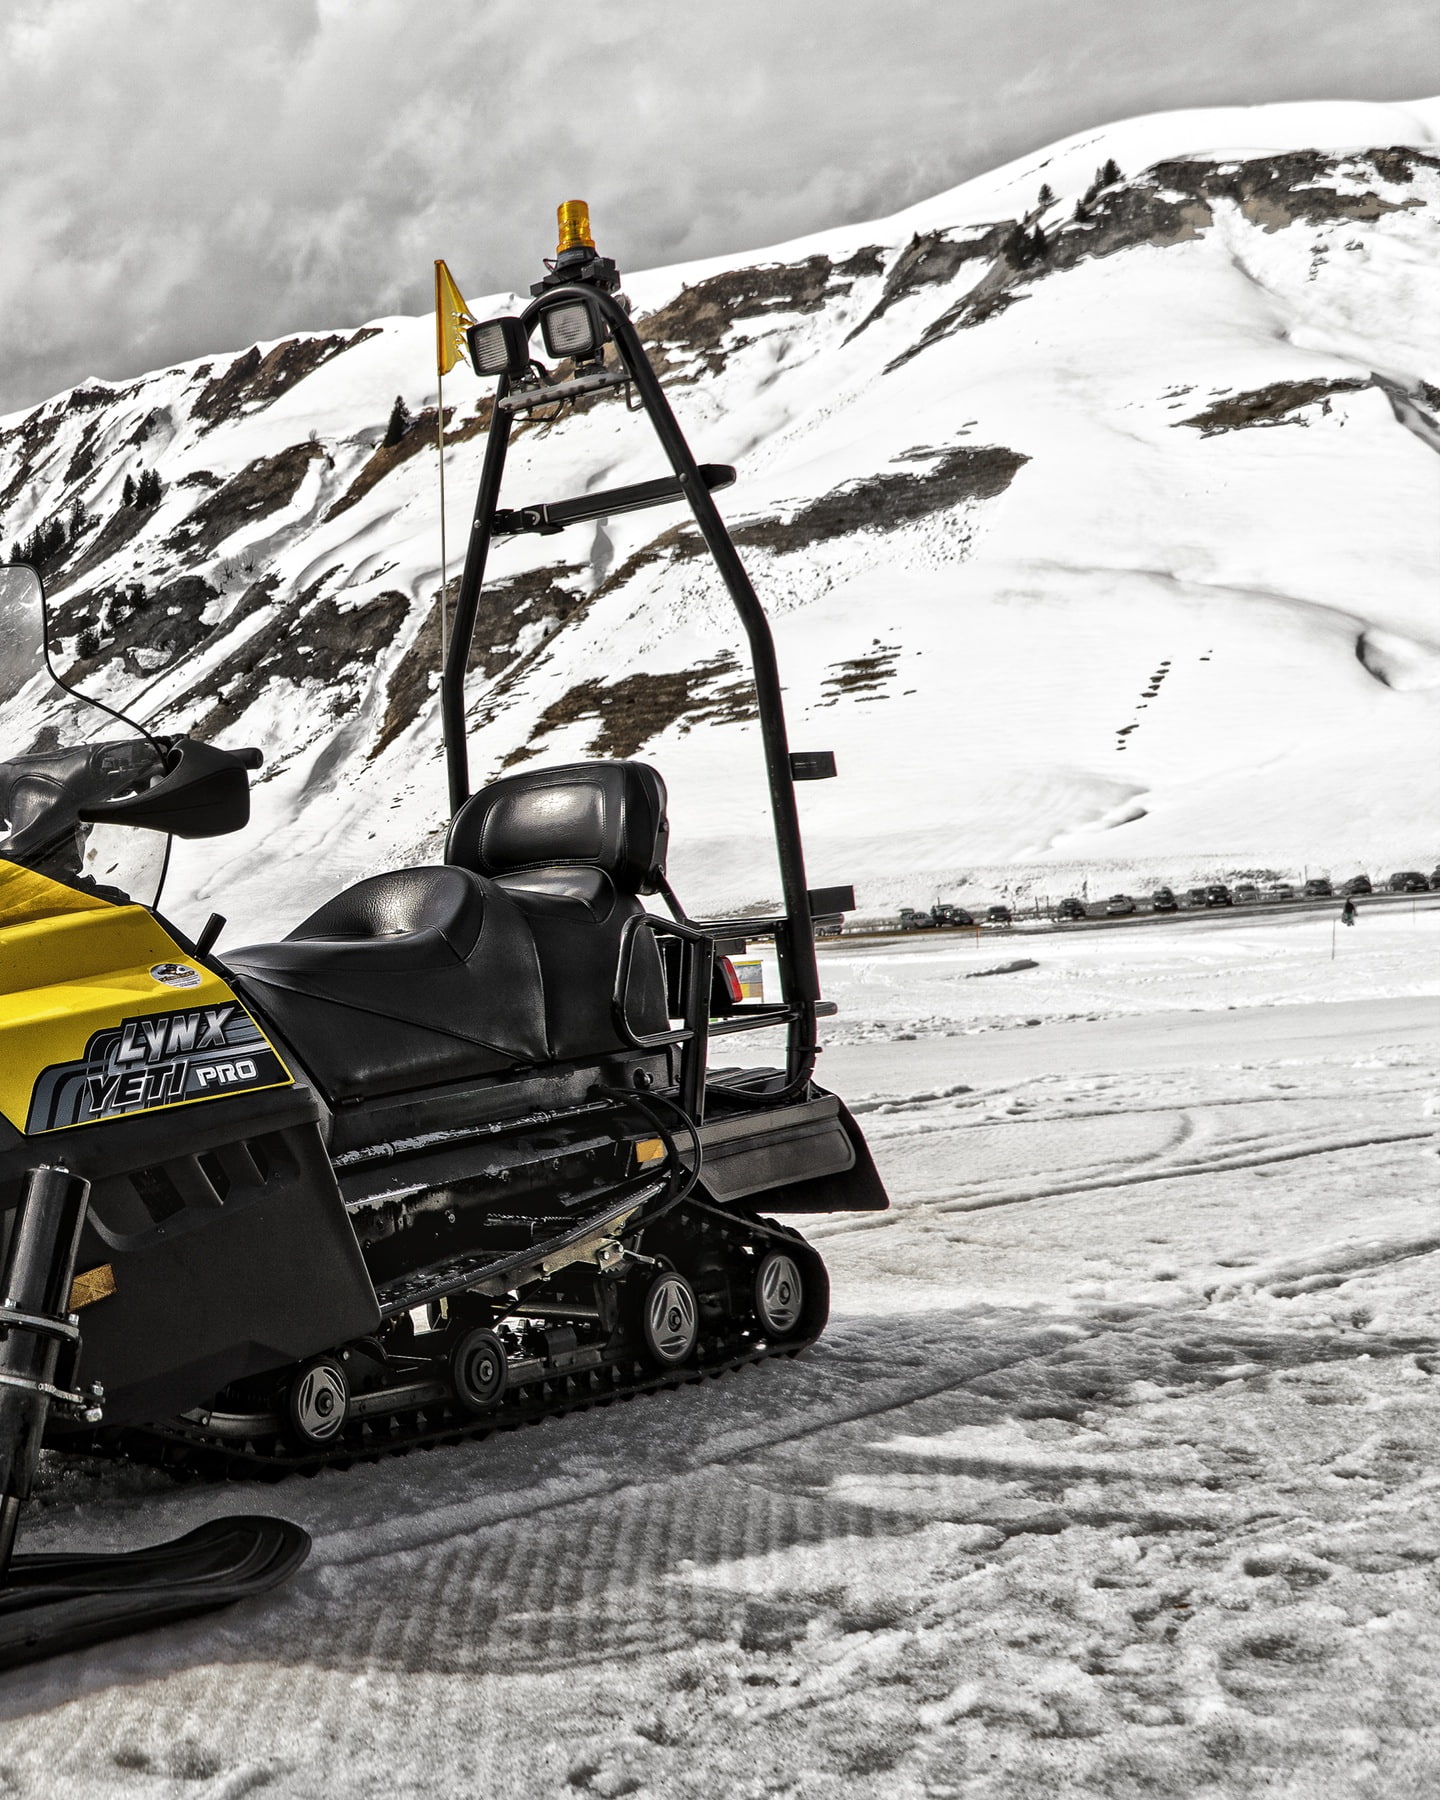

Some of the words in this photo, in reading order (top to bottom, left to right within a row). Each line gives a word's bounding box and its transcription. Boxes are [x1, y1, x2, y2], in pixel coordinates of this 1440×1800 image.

[116, 1007, 235, 1063] LYNX
[87, 1058, 190, 1113] YETI
[196, 1060, 258, 1087] PRO
